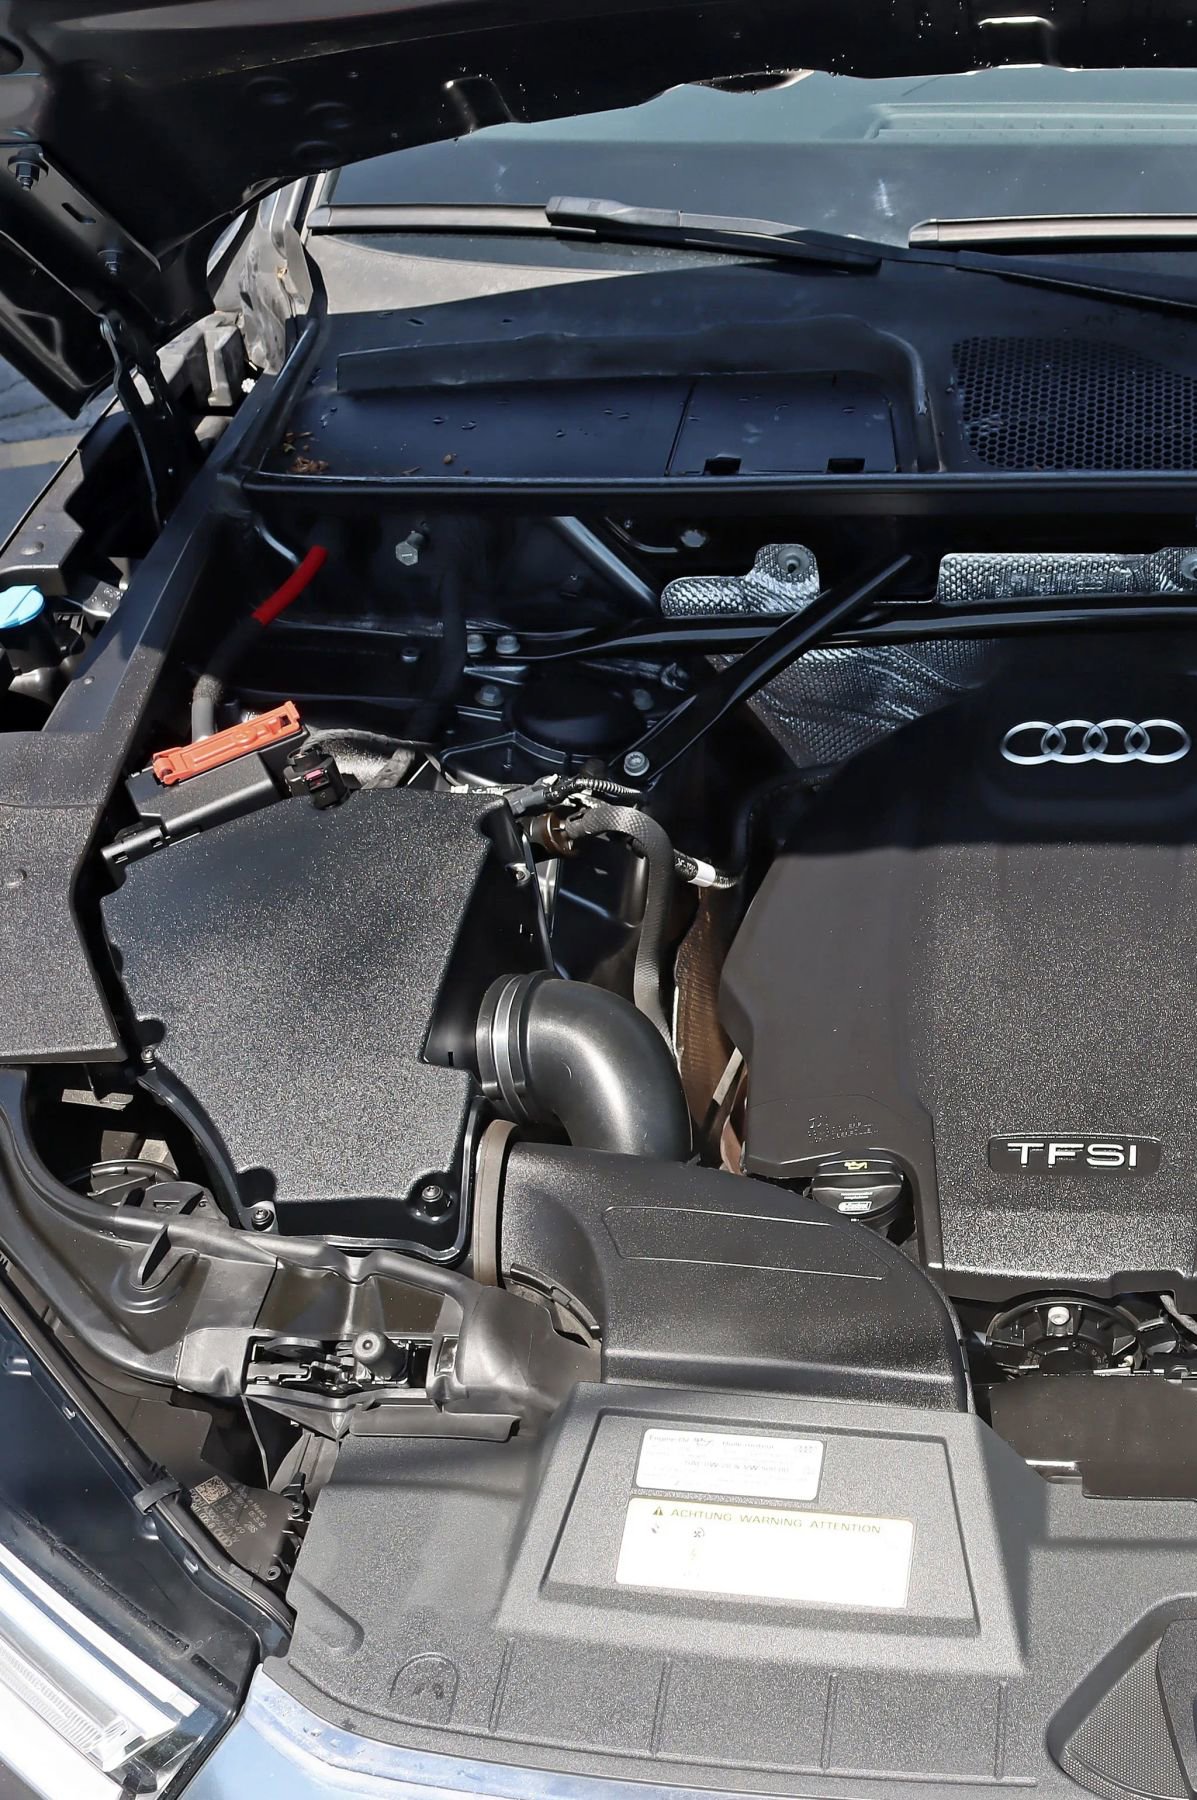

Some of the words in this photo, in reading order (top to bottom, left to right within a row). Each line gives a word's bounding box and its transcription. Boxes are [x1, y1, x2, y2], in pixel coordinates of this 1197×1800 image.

[1007, 1142, 1137, 1167] TFSI
[670, 1508, 733, 1522] ACHTUNG
[739, 1514, 803, 1528] WARNING
[810, 1519, 882, 1534] ATTENTION
